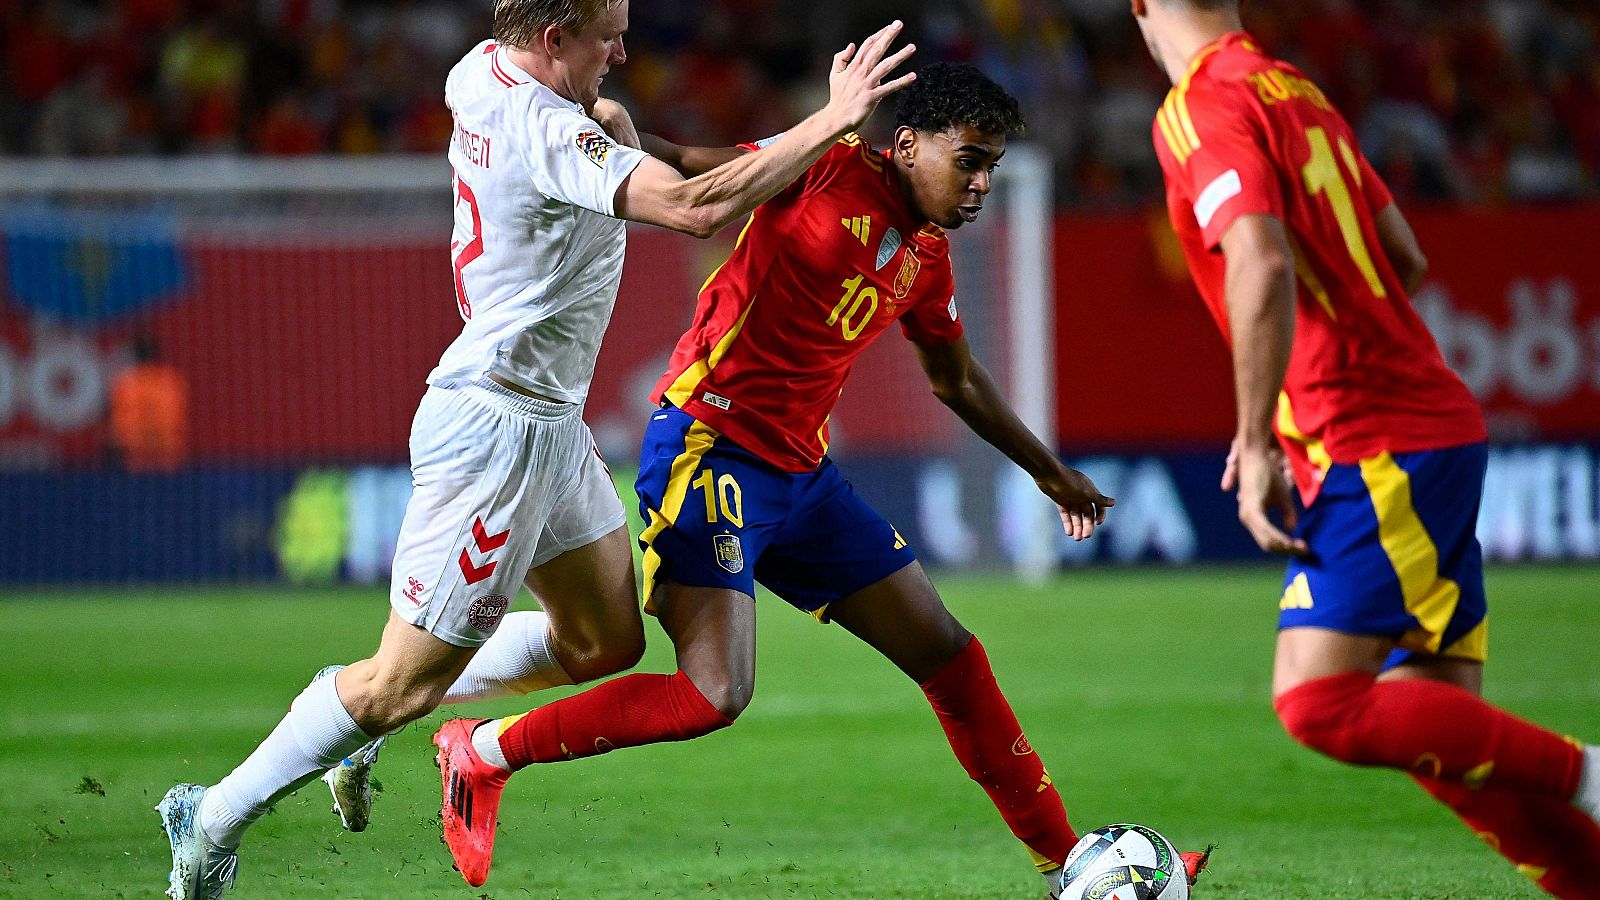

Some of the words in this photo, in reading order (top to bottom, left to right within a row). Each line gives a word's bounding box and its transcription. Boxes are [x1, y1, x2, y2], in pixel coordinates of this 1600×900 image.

[825, 274, 879, 341] 10
[692, 468, 744, 529] 10
[477, 606, 502, 618] DBU
